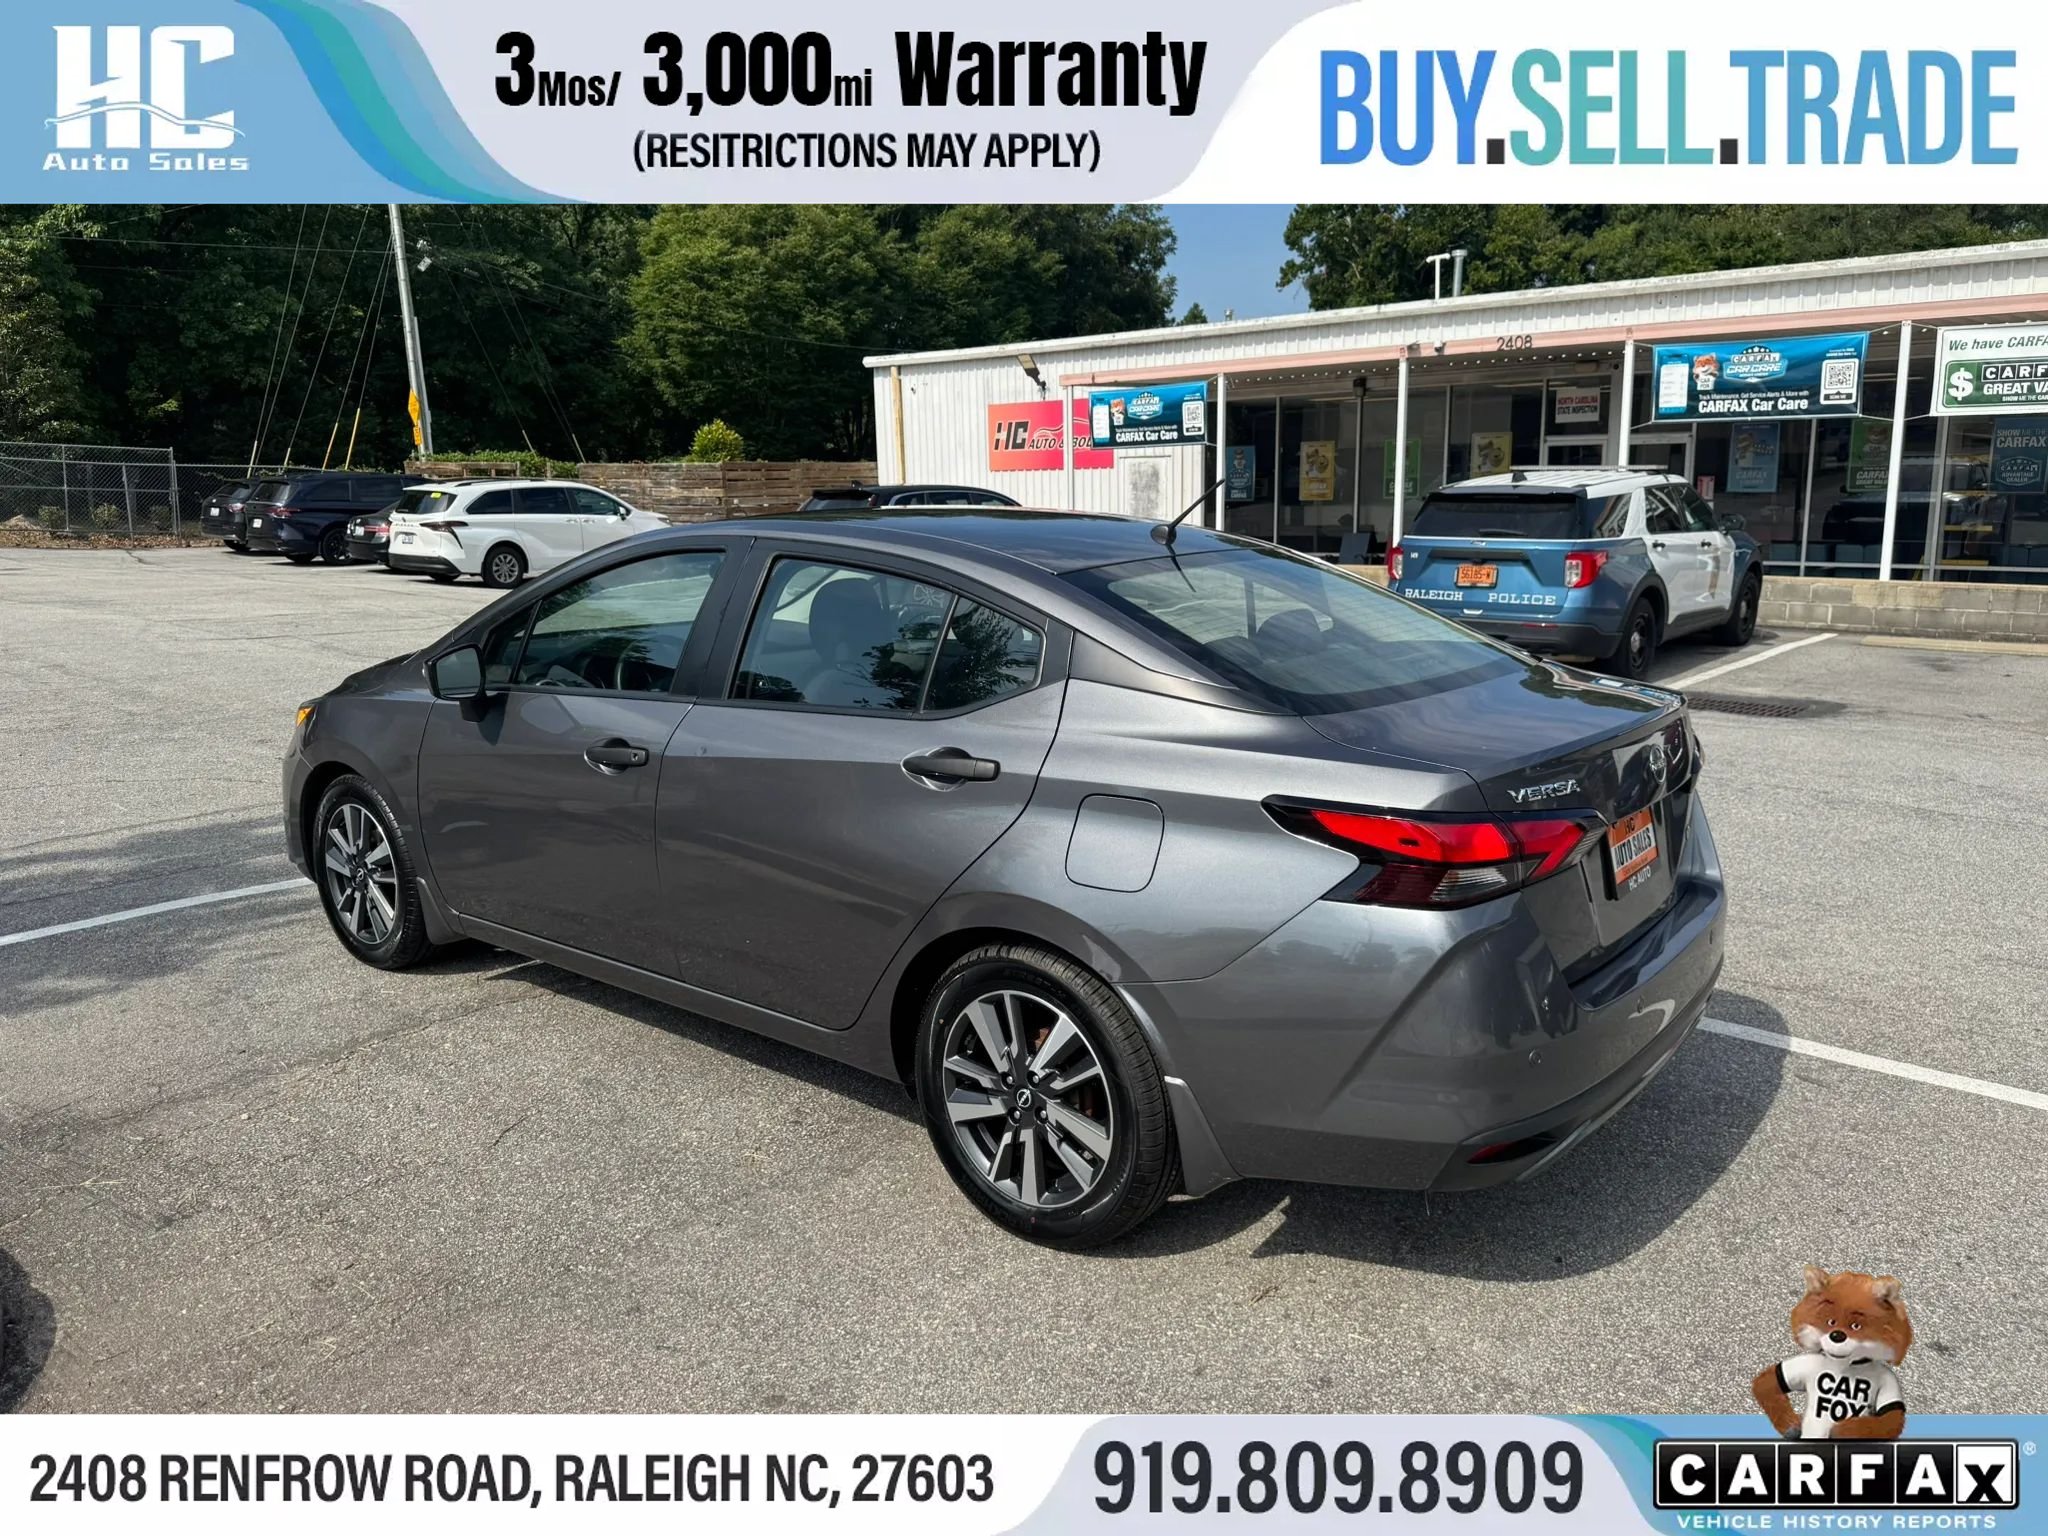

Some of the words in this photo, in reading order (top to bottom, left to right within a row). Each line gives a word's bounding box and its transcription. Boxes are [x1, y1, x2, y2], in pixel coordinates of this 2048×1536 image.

[1497, 335, 1532, 351] 2408
[1949, 340, 1968, 351] We
[1972, 338, 2003, 349] have
[1733, 353, 1780, 363] CARFAX
[1985, 365, 2048, 379] CARF
[1983, 382, 2031, 395] GREAT
[1558, 396, 1573, 405] NORTH
[1575, 395, 1598, 404] CAROLINA
[1698, 399, 1748, 413] CARFAX
[1751, 398, 1774, 412] Car
[1777, 397, 1808, 410] Care
[1557, 406, 1572, 415] STATE
[1572, 405, 1598, 414] INSPECTION
[994, 421, 1029, 450] HC
[1116, 431, 1144, 442] CARFAX
[1145, 431, 1158, 441] Car
[1160, 430, 1178, 440] Care
[1996, 436, 2047, 448] CARFAX
[1028, 437, 1056, 449] AUTO
[1405, 588, 1463, 601] RALEIGH
[1488, 592, 1556, 605] POLICE
[1507, 779, 1580, 803] VERSA
[1615, 839, 1633, 868] AUTO
[1633, 827, 1652, 856] SALES
